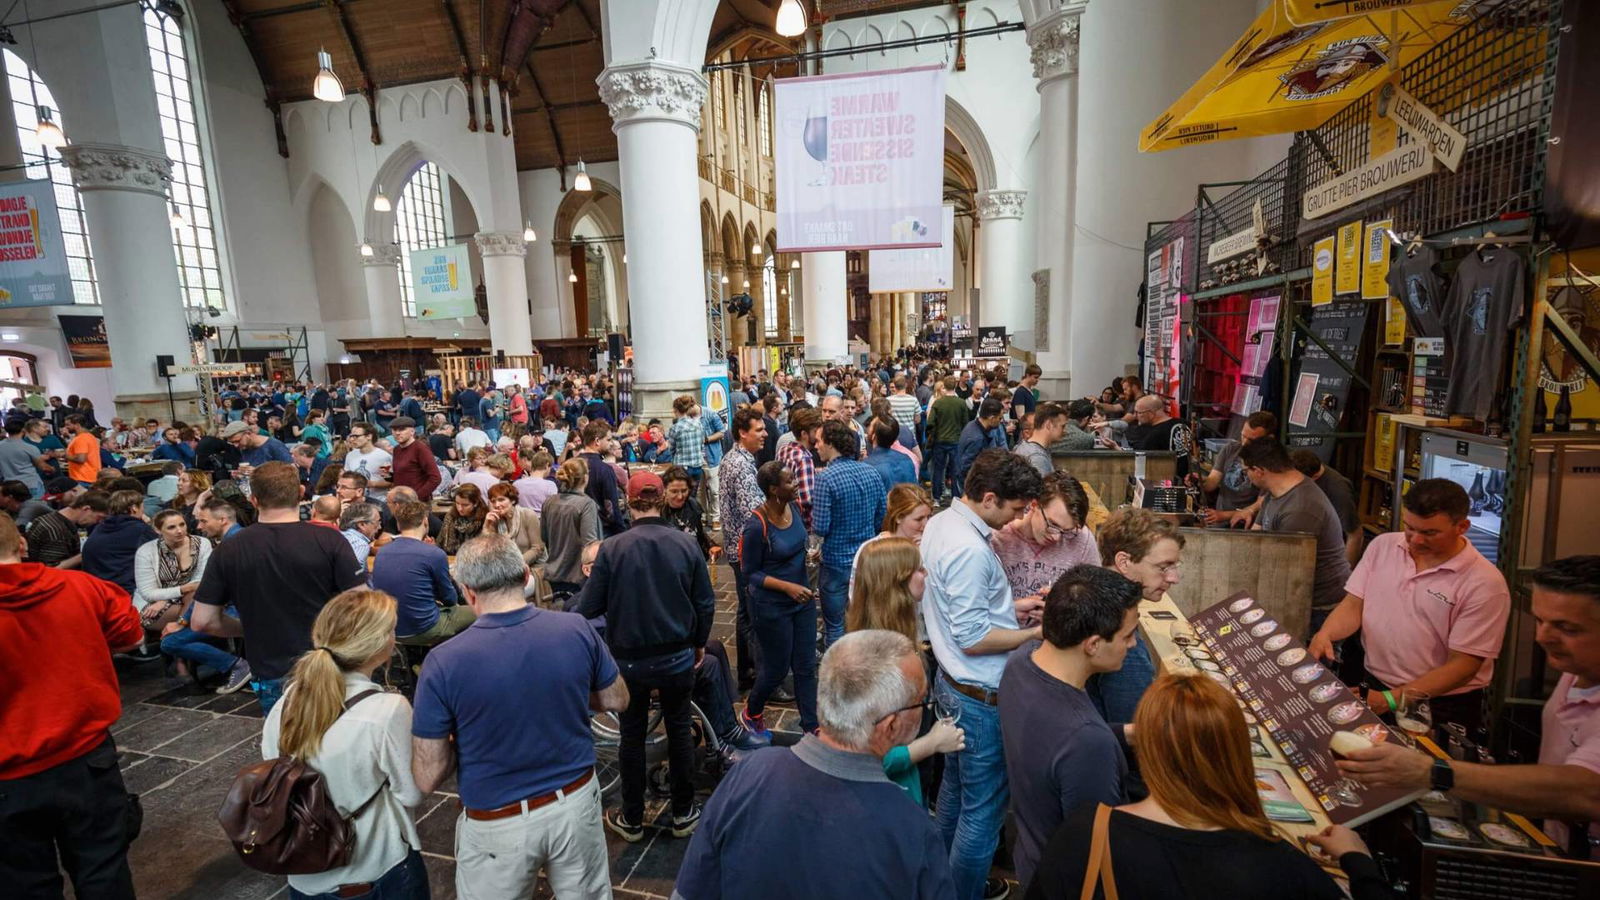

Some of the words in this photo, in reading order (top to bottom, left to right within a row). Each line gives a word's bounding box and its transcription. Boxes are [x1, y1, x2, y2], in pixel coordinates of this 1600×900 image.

[1394, 97, 1456, 158] LEEUWARDEN
[1307, 186, 1338, 212] GRUTTE
[1340, 174, 1358, 197] PIER
[1360, 147, 1426, 192] BROUWERIJ
[0, 213, 30, 229] TRAND
[0, 229, 34, 246] VONDJE
[1539, 377, 1584, 393] BROURIJ
